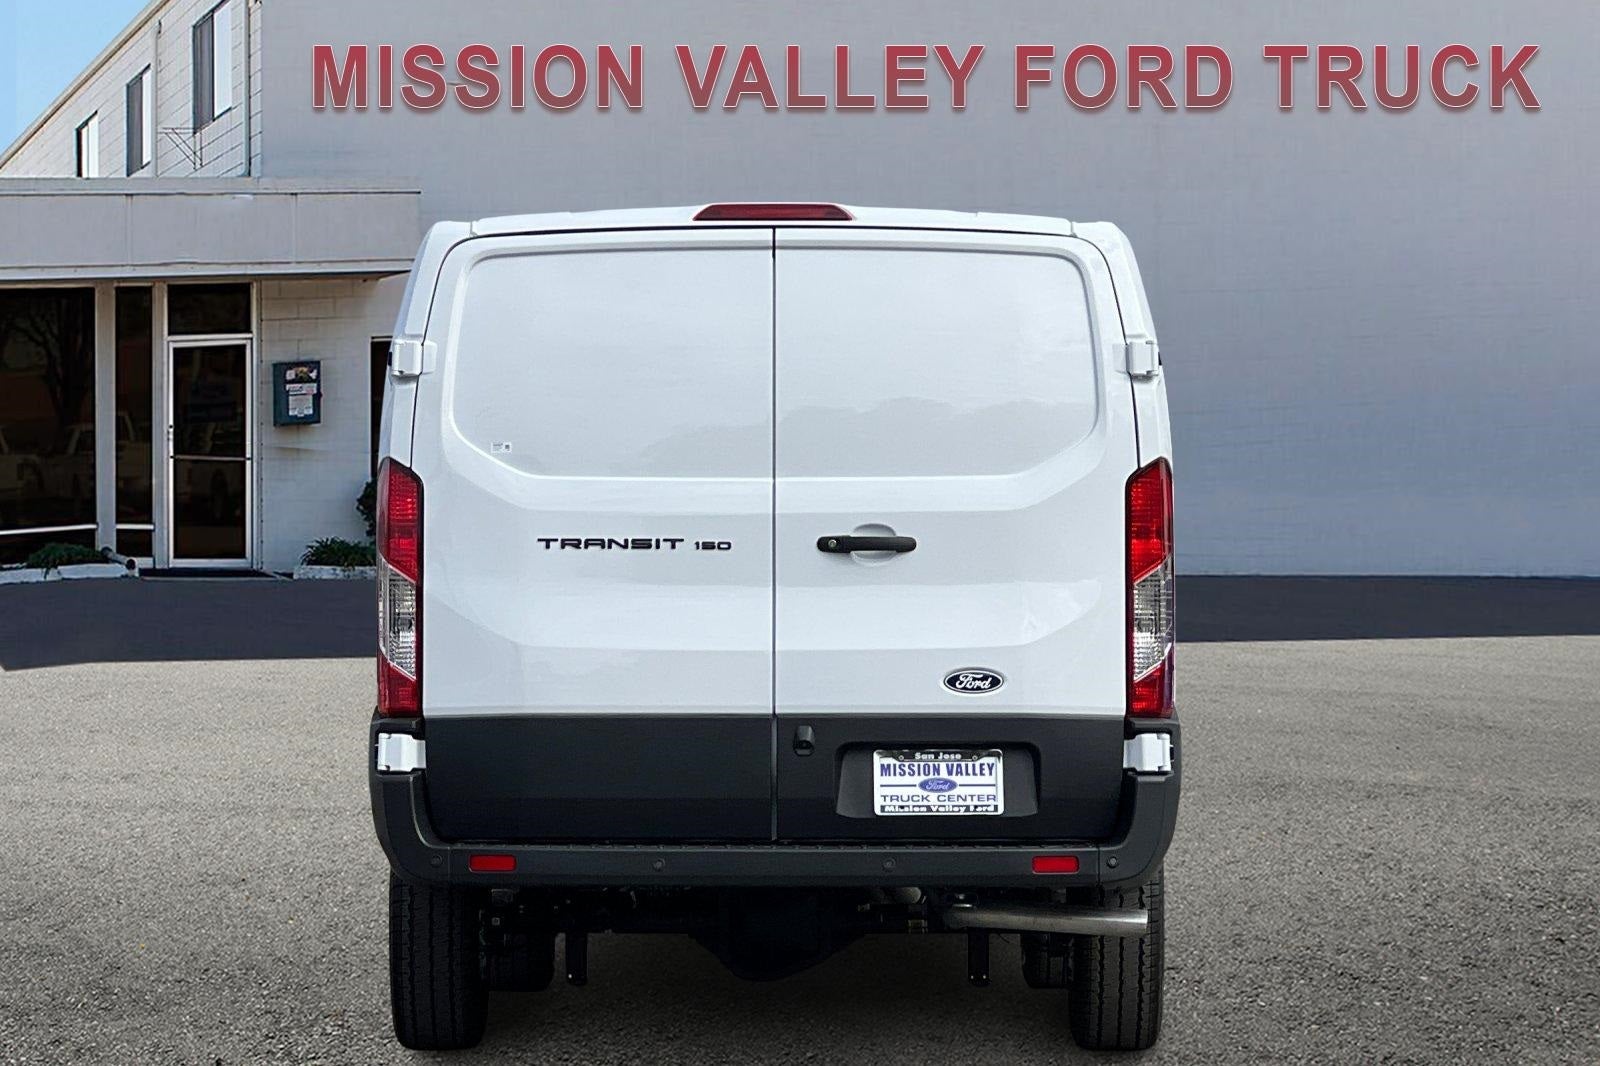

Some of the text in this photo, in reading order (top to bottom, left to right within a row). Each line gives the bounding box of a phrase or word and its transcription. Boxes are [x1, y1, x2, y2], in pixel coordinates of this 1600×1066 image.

[312, 43, 1541, 109] MISSION VALLEY FORD TRUCK
[537, 538, 732, 550] TRANSIT 150
[955, 673, 992, 689] Ford
[914, 752, 962, 760] San Jose
[880, 763, 995, 777] MISSION VALLEY
[925, 780, 950, 790] Ford
[881, 794, 996, 802] TRUCK CENTER
[930, 805, 966, 813] Valley
